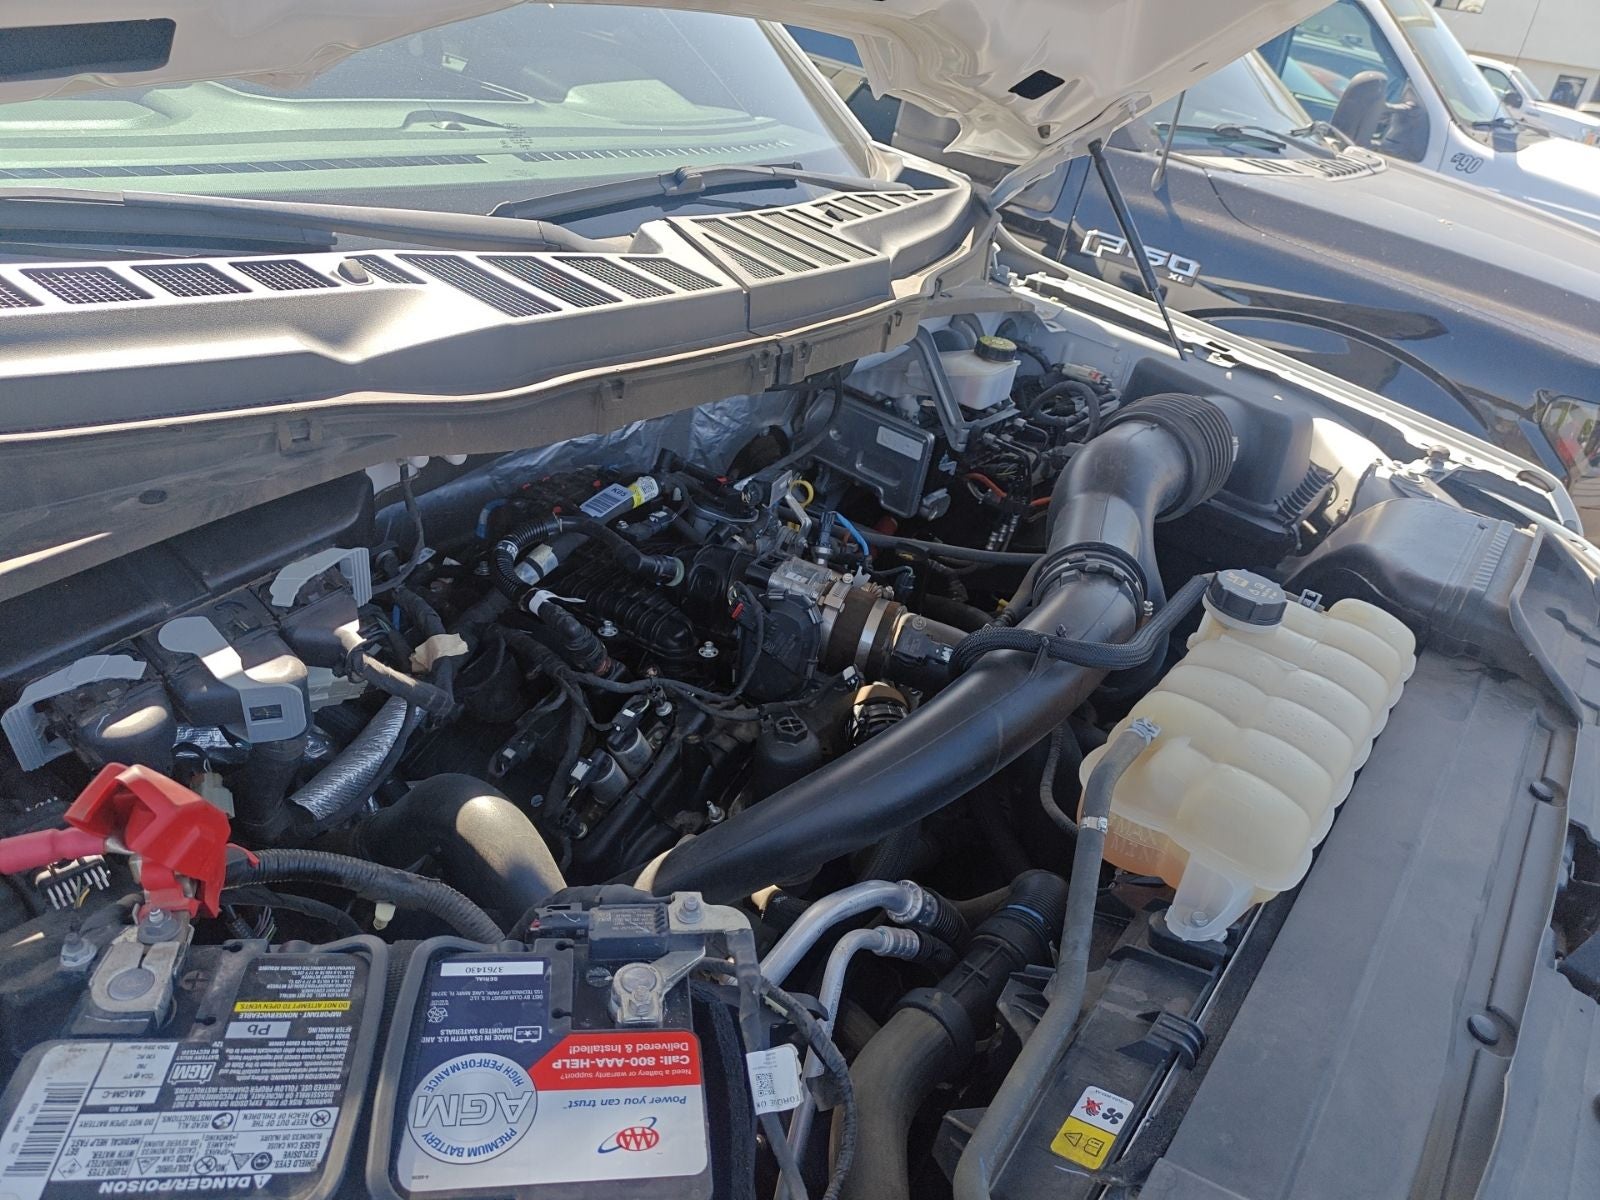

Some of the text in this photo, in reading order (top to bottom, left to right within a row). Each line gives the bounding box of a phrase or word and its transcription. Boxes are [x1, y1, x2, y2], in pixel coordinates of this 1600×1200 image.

[1080, 229, 1200, 278] F50
[248, 1024, 271, 1036] Pb
[569, 1042, 689, 1054] Delivered & Installed!
[551, 1054, 690, 1069] Call: 800-AAA-HELP
[172, 1064, 212, 1079] AGM
[423, 1058, 525, 1094] HIGH PERFORMANCE
[560, 1071, 594, 1080] support?
[594, 1070, 627, 1078] warranty
[638, 1068, 664, 1078] battery
[672, 1068, 692, 1076] Need
[568, 1095, 687, 1109] Power you can trust
[412, 1090, 534, 1128] AGM
[291, 1118, 308, 1126] KEEP
[110, 1137, 140, 1146] MEDICAL
[300, 1141, 320, 1149] GASES
[421, 1127, 517, 1158] PREMIUM BATTERY
[620, 1127, 653, 1151] AAA
[283, 1150, 318, 1159] EXPLOSIVE
[98, 1176, 251, 1193] DANGER/POISON
